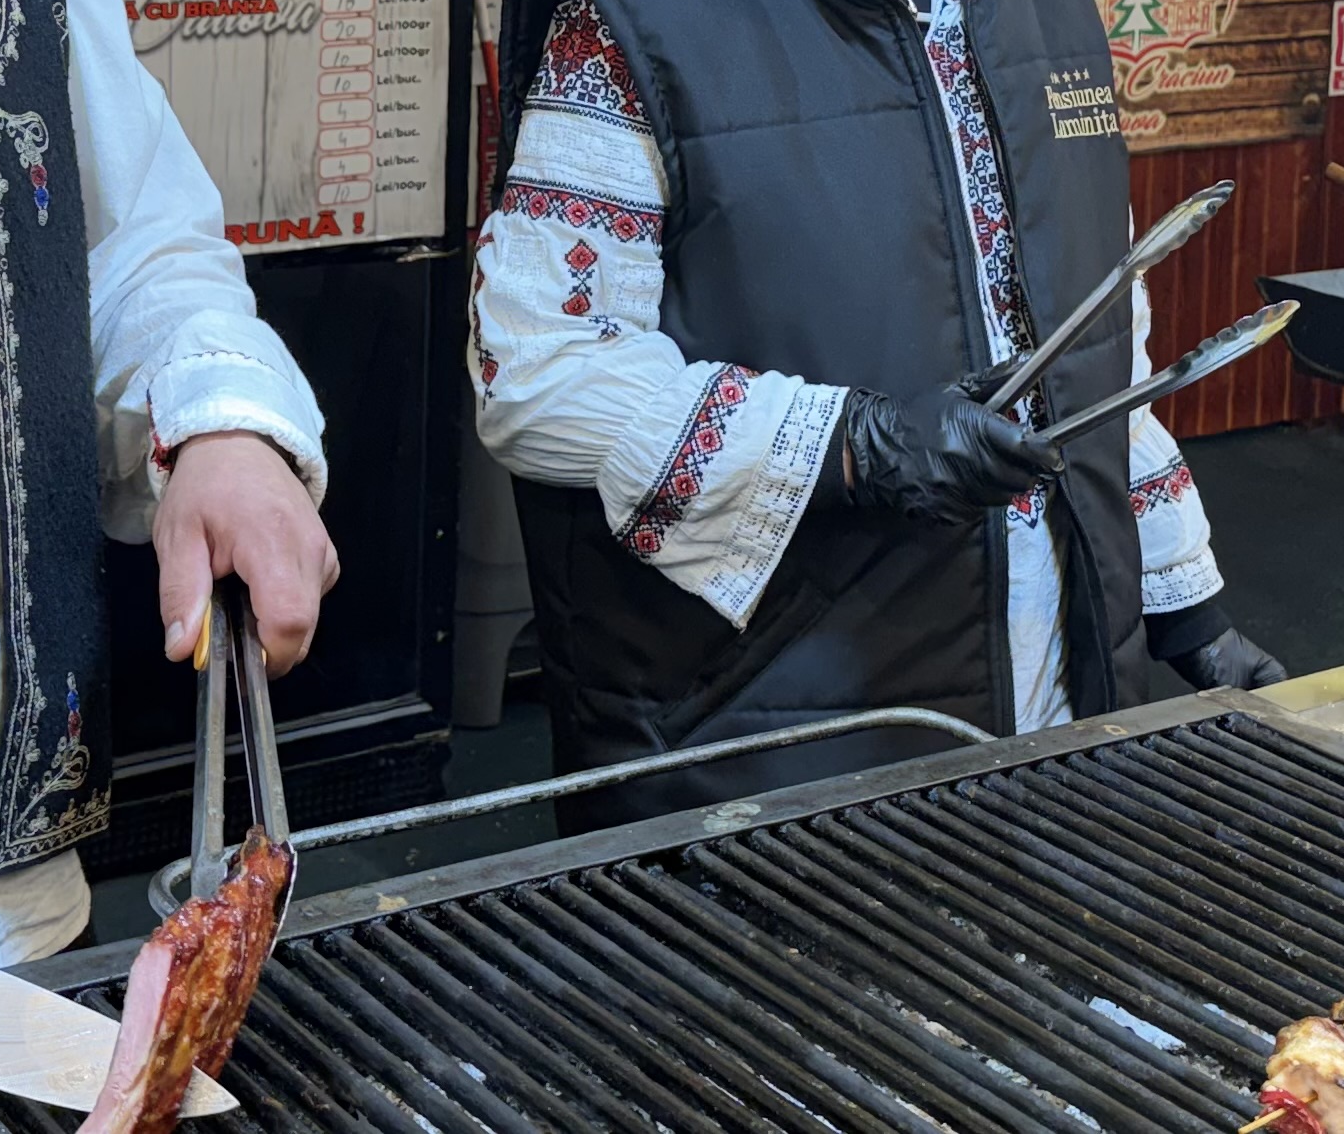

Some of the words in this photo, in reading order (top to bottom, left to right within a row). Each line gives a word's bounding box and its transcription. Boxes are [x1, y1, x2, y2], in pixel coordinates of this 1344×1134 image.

[145, 2, 179, 19] CU
[224, 209, 342, 246] BUNĂ
[352, 211, 365, 235] !
